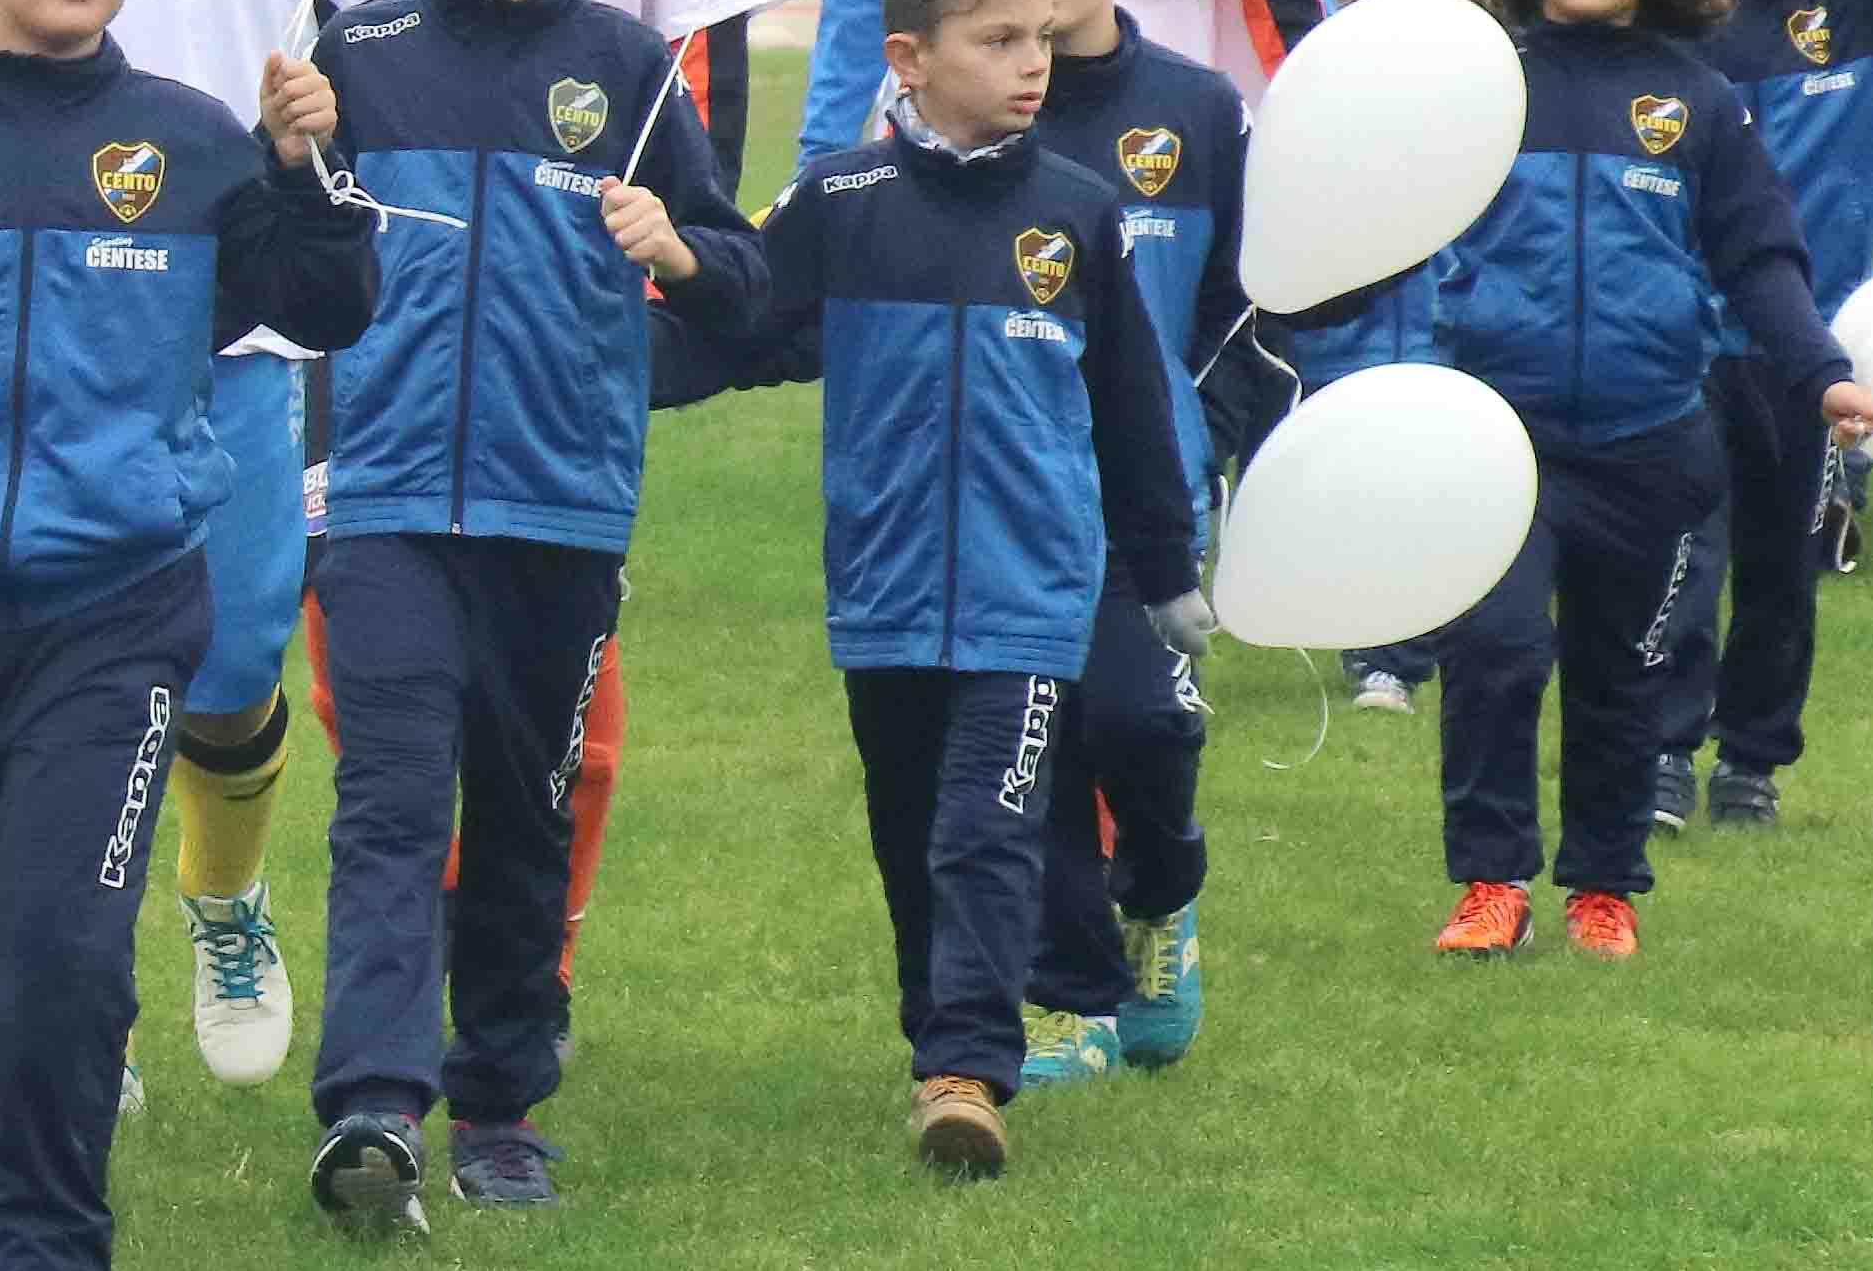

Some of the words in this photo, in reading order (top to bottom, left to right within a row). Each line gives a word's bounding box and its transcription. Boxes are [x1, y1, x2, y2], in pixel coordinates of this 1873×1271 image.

[344, 12, 421, 43] Kappa
[100, 170, 156, 191] CENTO
[823, 165, 898, 194] Kappa
[85, 245, 169, 271] CENTESE
[98, 686, 171, 890] Kappa
